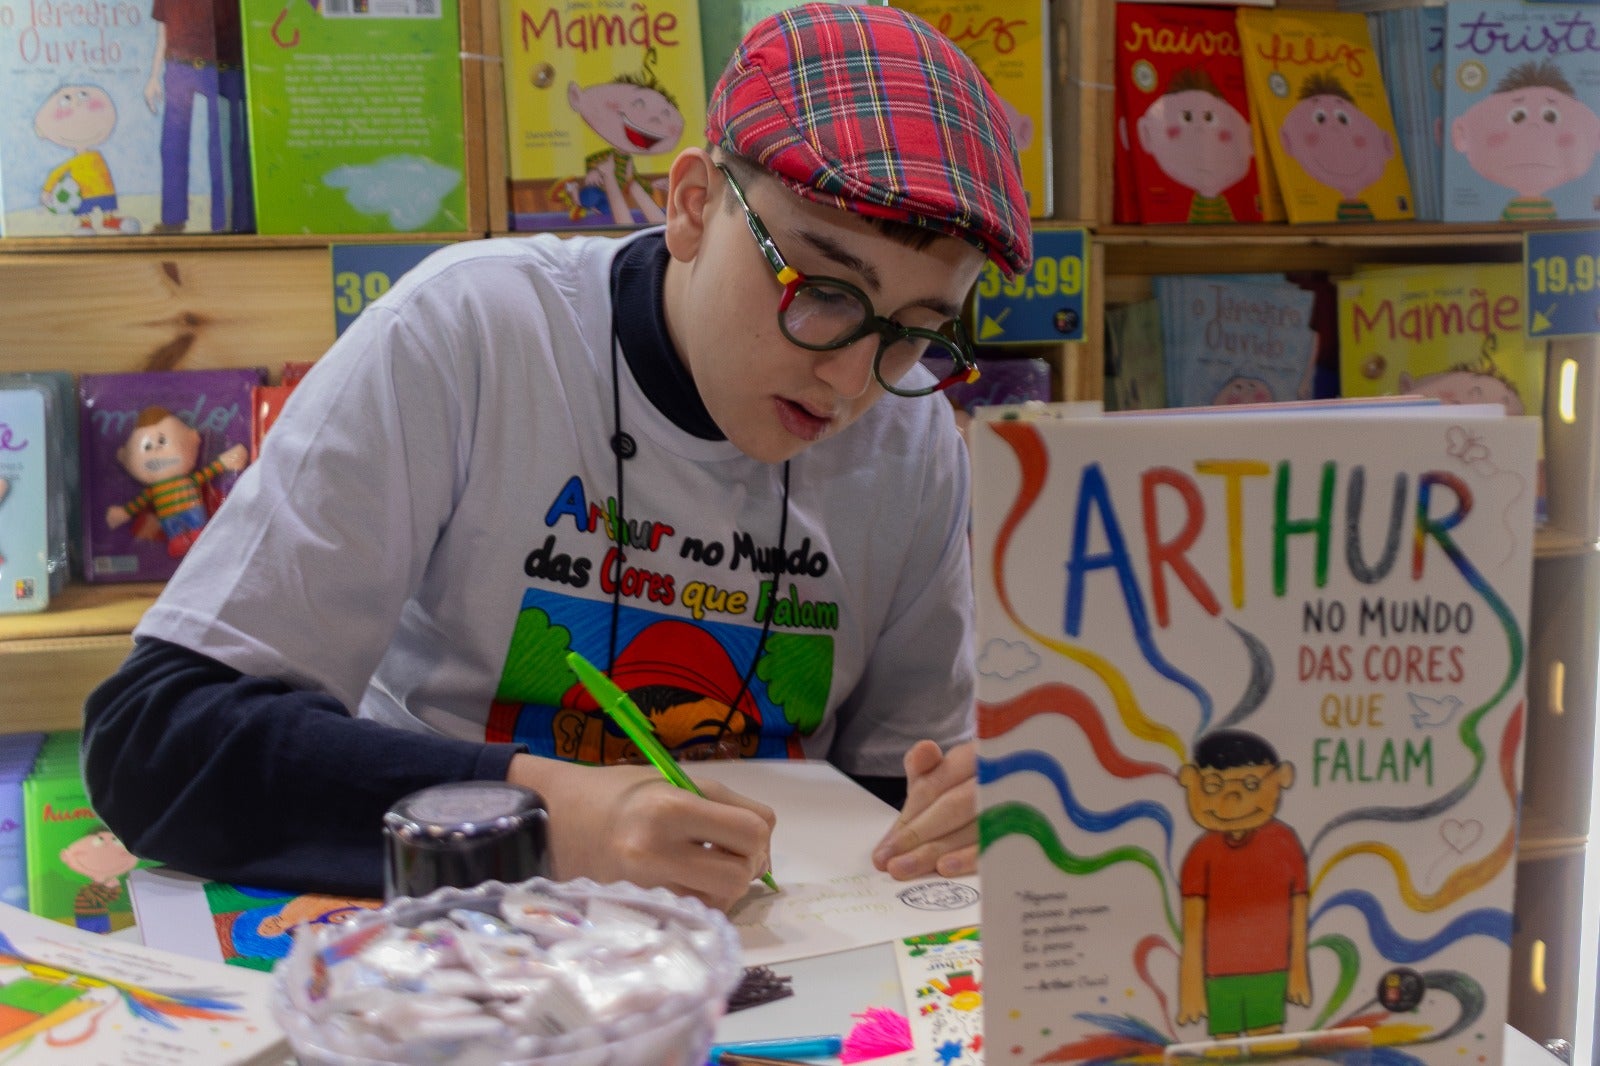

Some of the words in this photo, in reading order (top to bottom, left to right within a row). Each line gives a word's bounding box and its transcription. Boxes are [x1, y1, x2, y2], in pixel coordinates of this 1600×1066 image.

[19, 26, 122, 64] Ouvido
[520, 3, 680, 54] Mamãe
[938, 12, 1029, 55] liz
[1124, 21, 1241, 57] raiva
[1455, 11, 1600, 55] triste
[1531, 254, 1600, 296] 19,9
[1352, 288, 1523, 344] Mamãe
[91, 394, 240, 437] mdo
[545, 475, 676, 551] Arthur
[680, 534, 726, 566] no
[729, 530, 829, 578] Mundo
[1062, 458, 1482, 638] ARTHUR
[524, 535, 592, 588] das
[600, 546, 676, 606] Cores
[681, 580, 749, 620] que
[753, 580, 839, 630] Falam
[1302, 599, 1345, 635] NO
[1359, 597, 1474, 637] MUNDO
[1299, 645, 1353, 684] DAS
[1363, 645, 1466, 685] CORES
[1320, 692, 1385, 729] QUE
[1312, 736, 1435, 788] FALAM
[43, 803, 97, 822] hum
